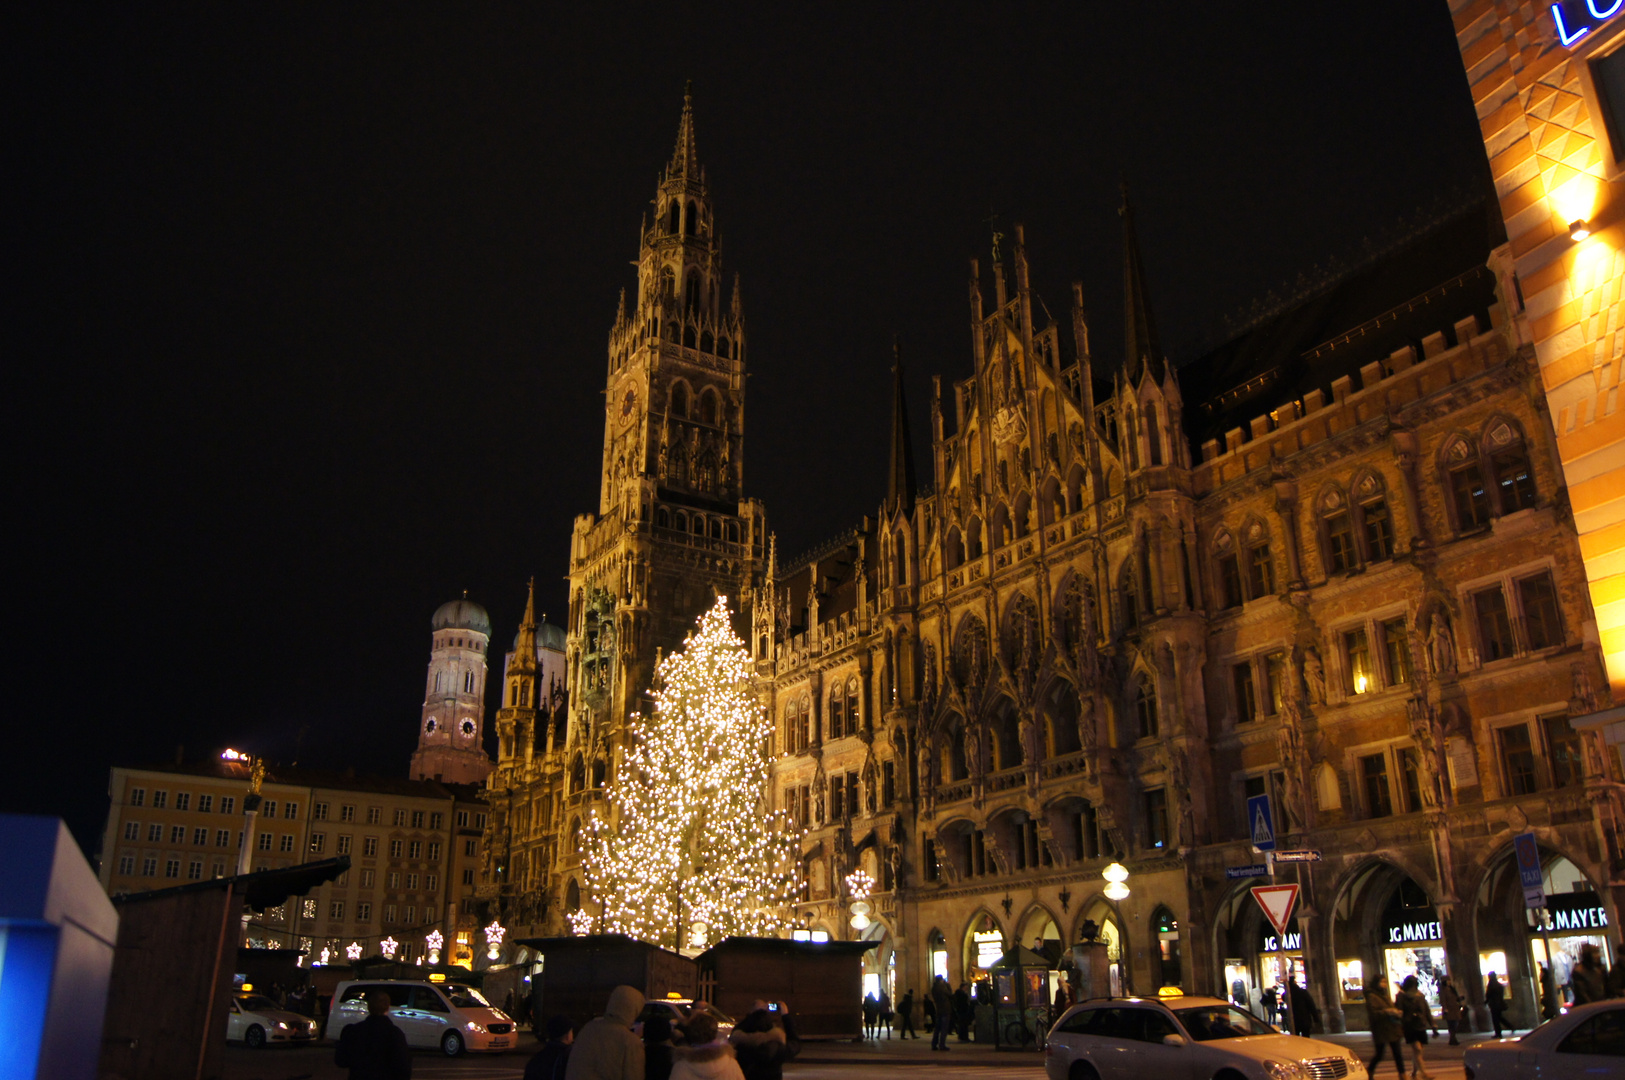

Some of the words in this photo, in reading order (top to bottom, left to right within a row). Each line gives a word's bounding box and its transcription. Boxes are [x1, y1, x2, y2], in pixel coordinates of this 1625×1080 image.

[1522, 870, 1540, 883] TAXI
[1555, 907, 1608, 930] MAYER
[1389, 926, 1402, 943] JG
[1264, 936, 1278, 951] JG
